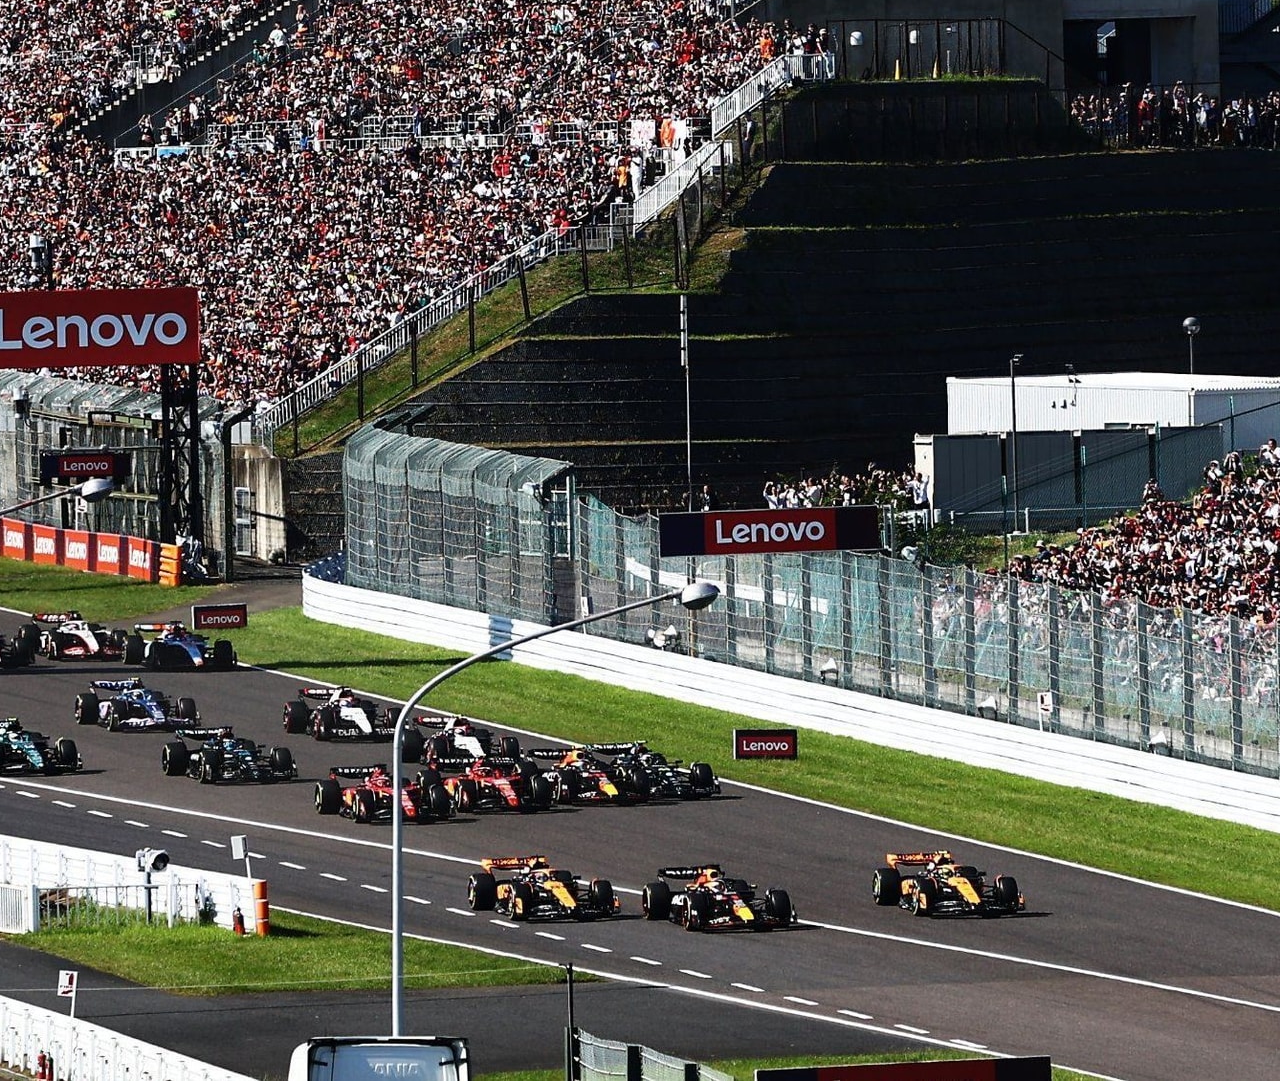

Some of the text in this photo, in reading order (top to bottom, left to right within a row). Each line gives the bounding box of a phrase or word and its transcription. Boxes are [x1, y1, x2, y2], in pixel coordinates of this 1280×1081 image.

[63, 460, 109, 472] Lenovo
[4, 525, 24, 550] Lenovo
[34, 531, 56, 556] Lenovo
[715, 520, 825, 544] Lenovo
[66, 536, 87, 560] Lenovo
[98, 540, 120, 564] Lenovo
[201, 614, 240, 624] Lenovo
[742, 739, 790, 753] Lenovo
